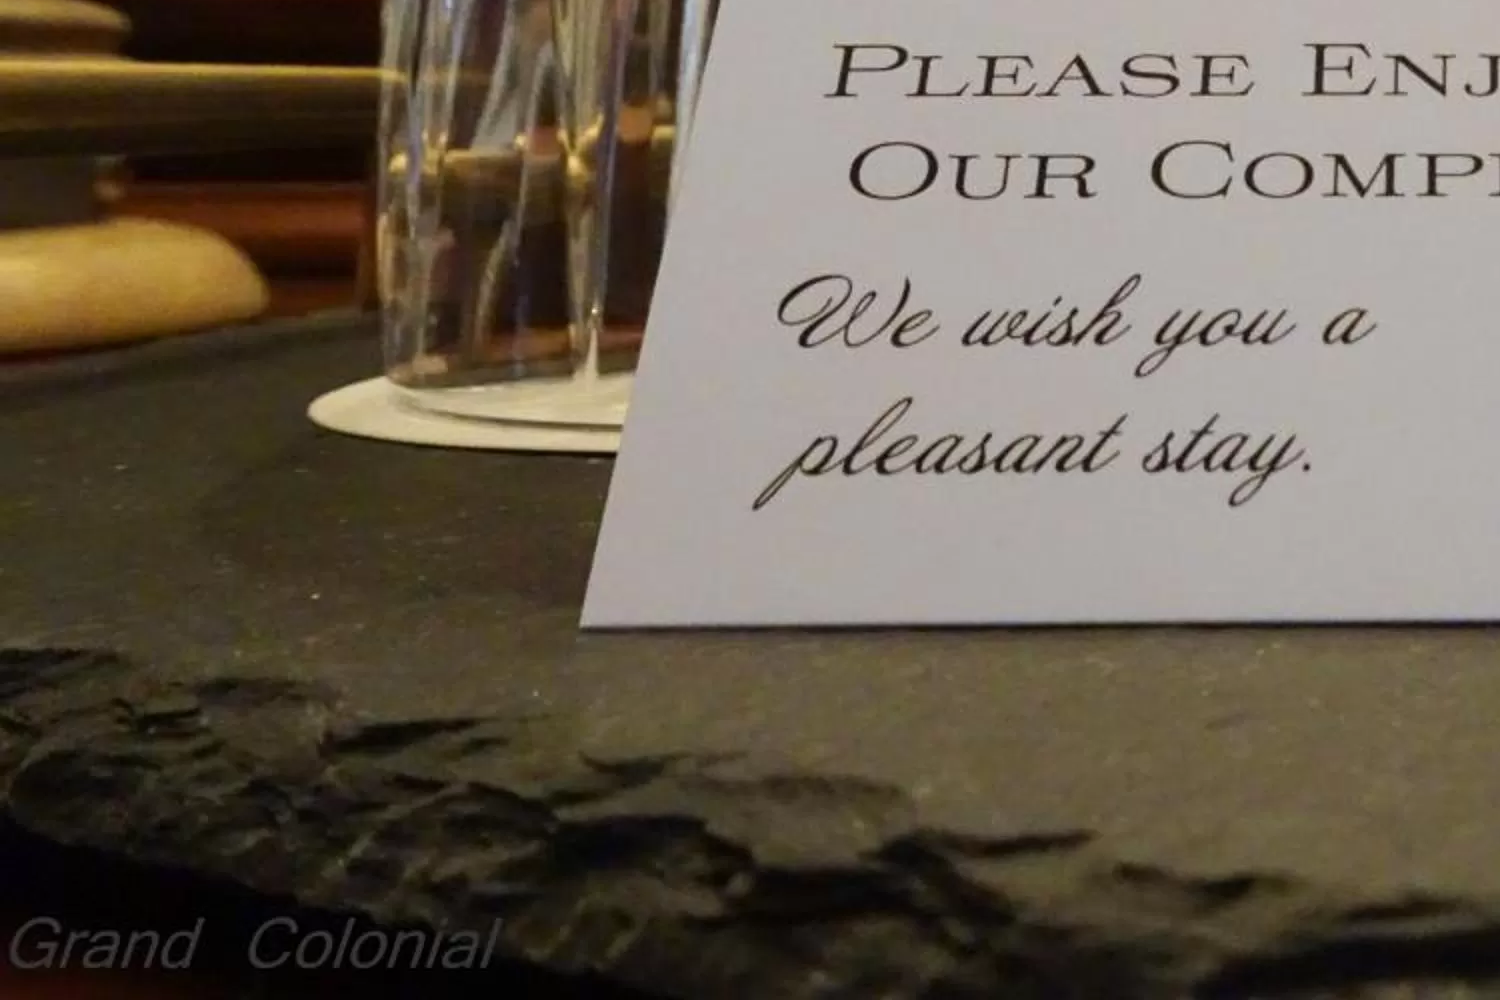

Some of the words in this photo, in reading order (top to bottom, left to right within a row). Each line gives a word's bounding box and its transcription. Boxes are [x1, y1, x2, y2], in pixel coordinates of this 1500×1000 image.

[824, 43, 1256, 99] PLEASE
[849, 142, 1098, 201] OUR
[777, 274, 940, 349] We
[961, 274, 1141, 348] wish
[1133, 305, 1297, 379] you
[1322, 308, 1378, 346] a
[752, 397, 1128, 512] pleasant
[1141, 413, 1312, 508] stay.
